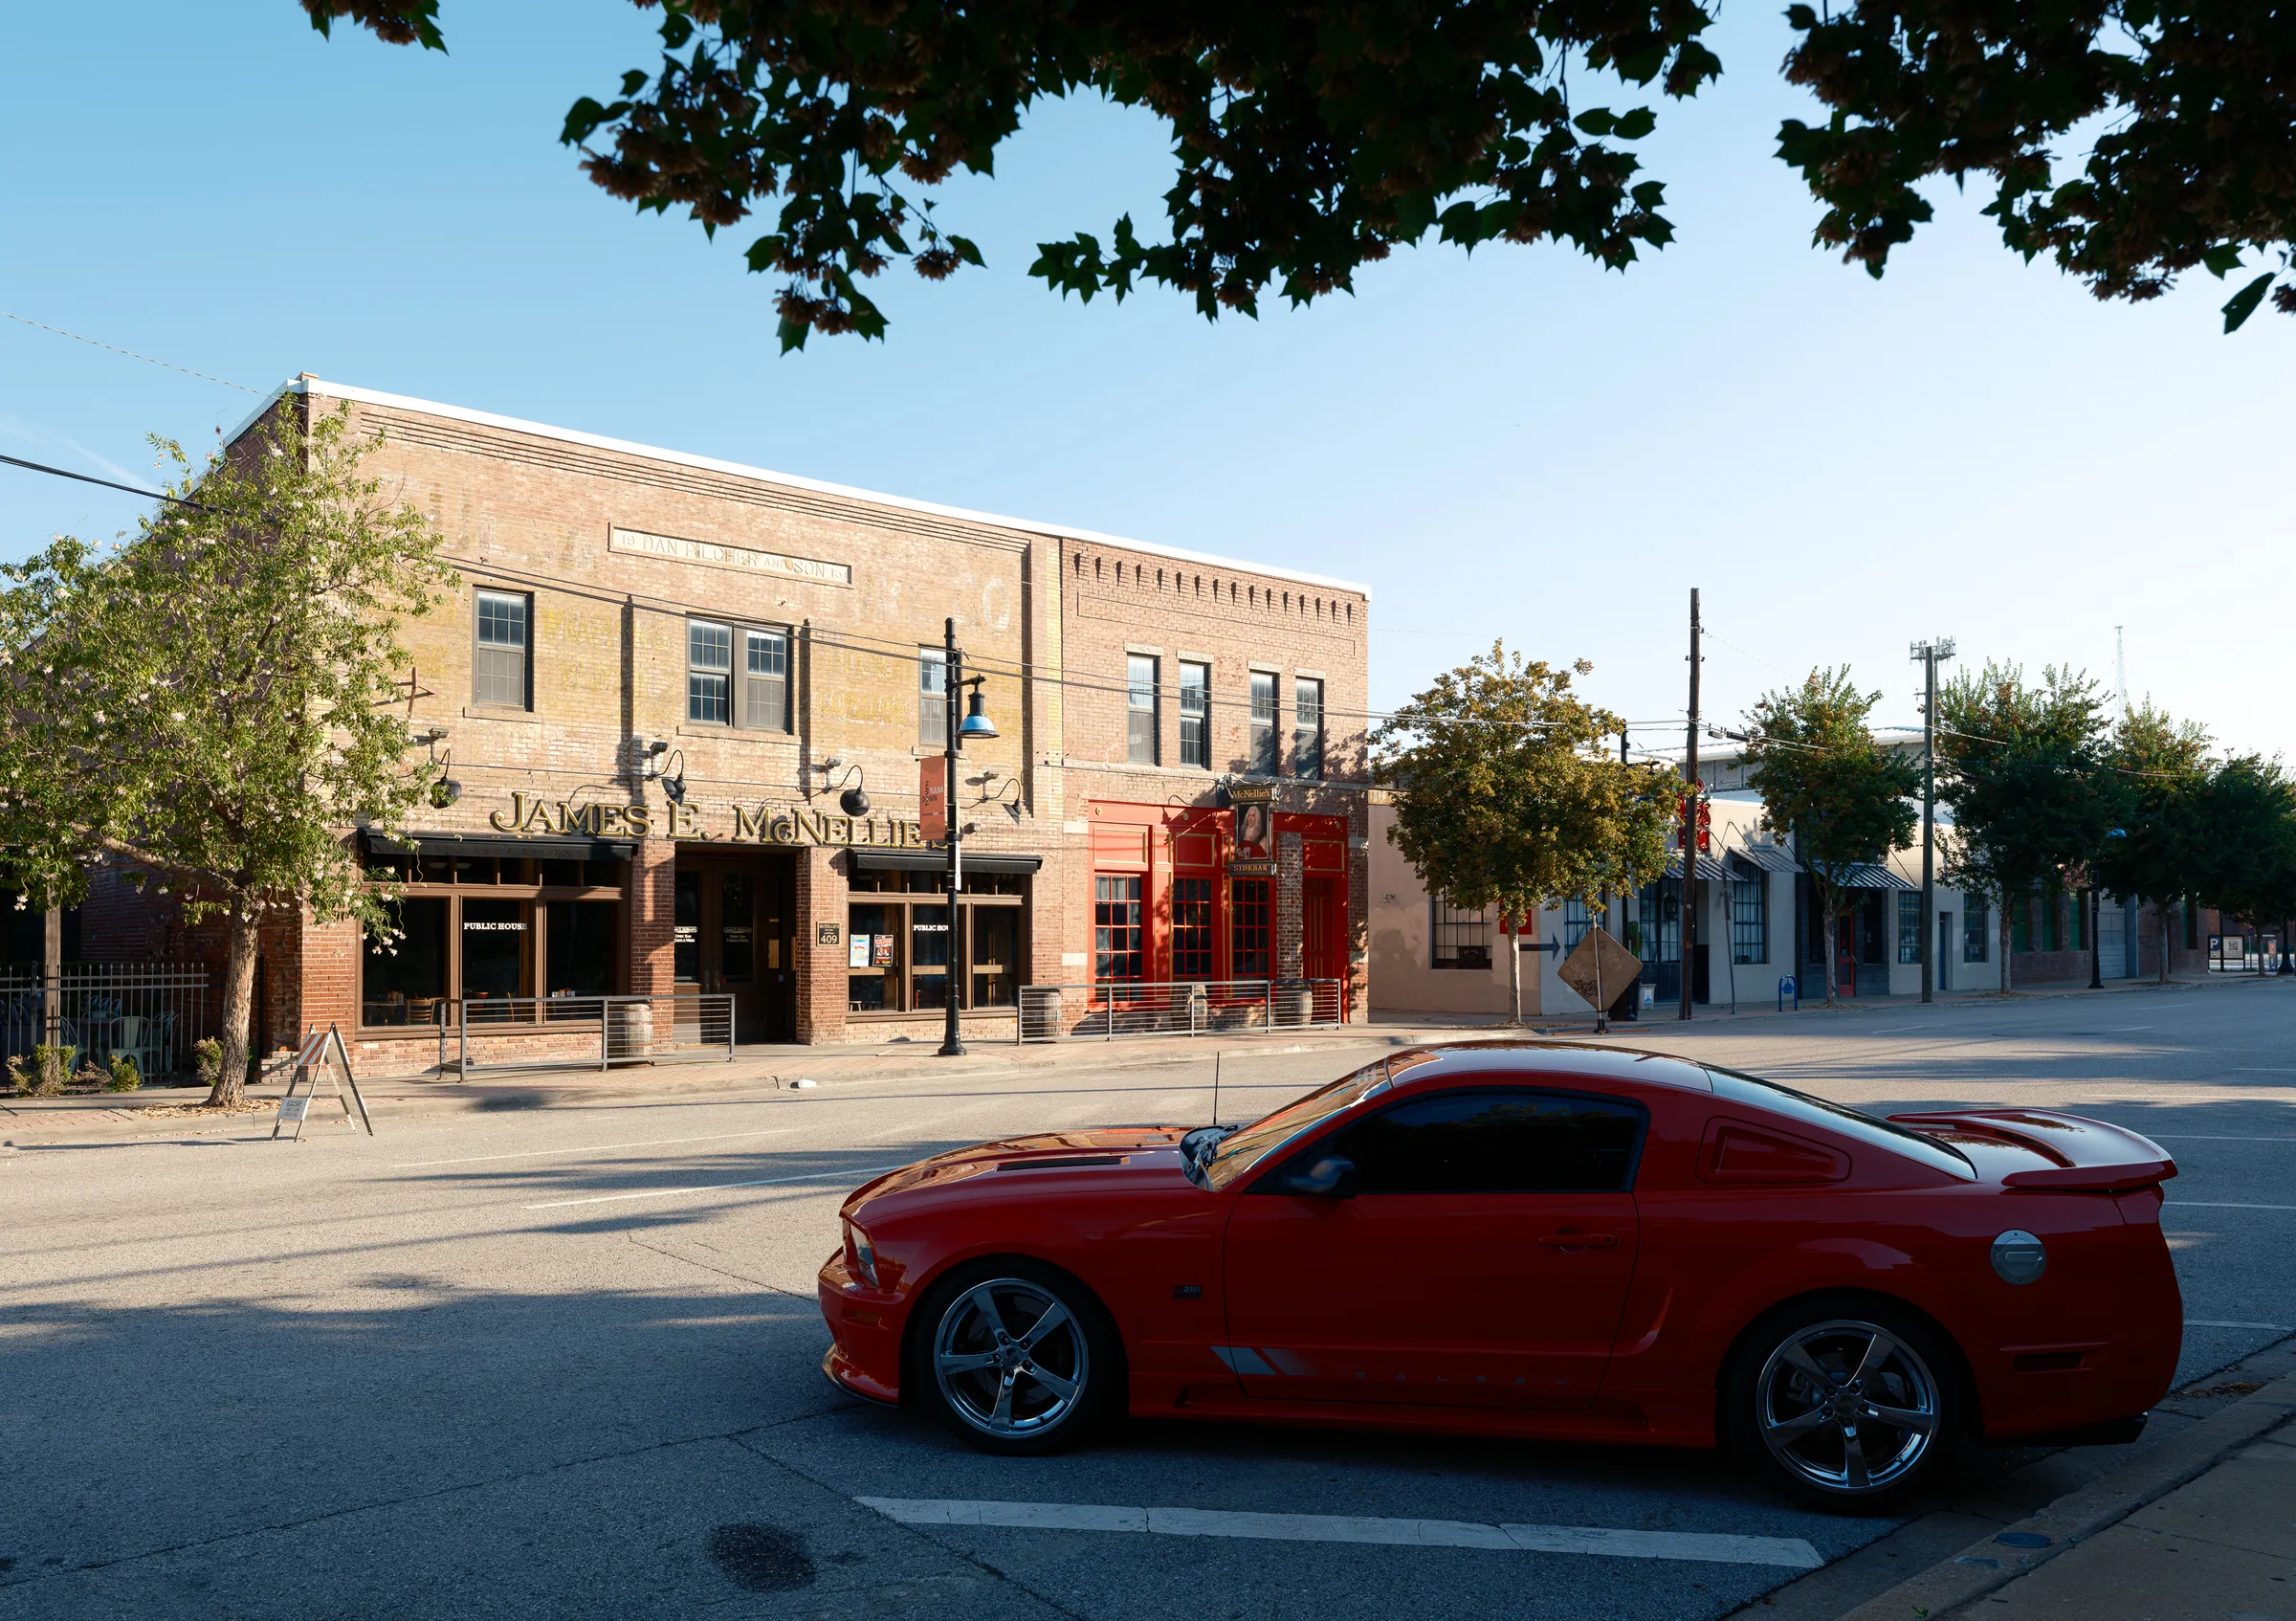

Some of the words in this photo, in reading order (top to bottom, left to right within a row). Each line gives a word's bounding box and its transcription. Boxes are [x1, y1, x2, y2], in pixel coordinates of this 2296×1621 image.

[643, 536, 677, 555] DAN
[685, 543, 758, 566] PILCHER
[793, 561, 825, 578] SON
[929, 786, 943, 794] TULSA
[1232, 788, 1270, 800] McNellie's
[489, 791, 651, 837] JAMES
[667, 800, 711, 841] E.
[820, 934, 838, 944] 409
